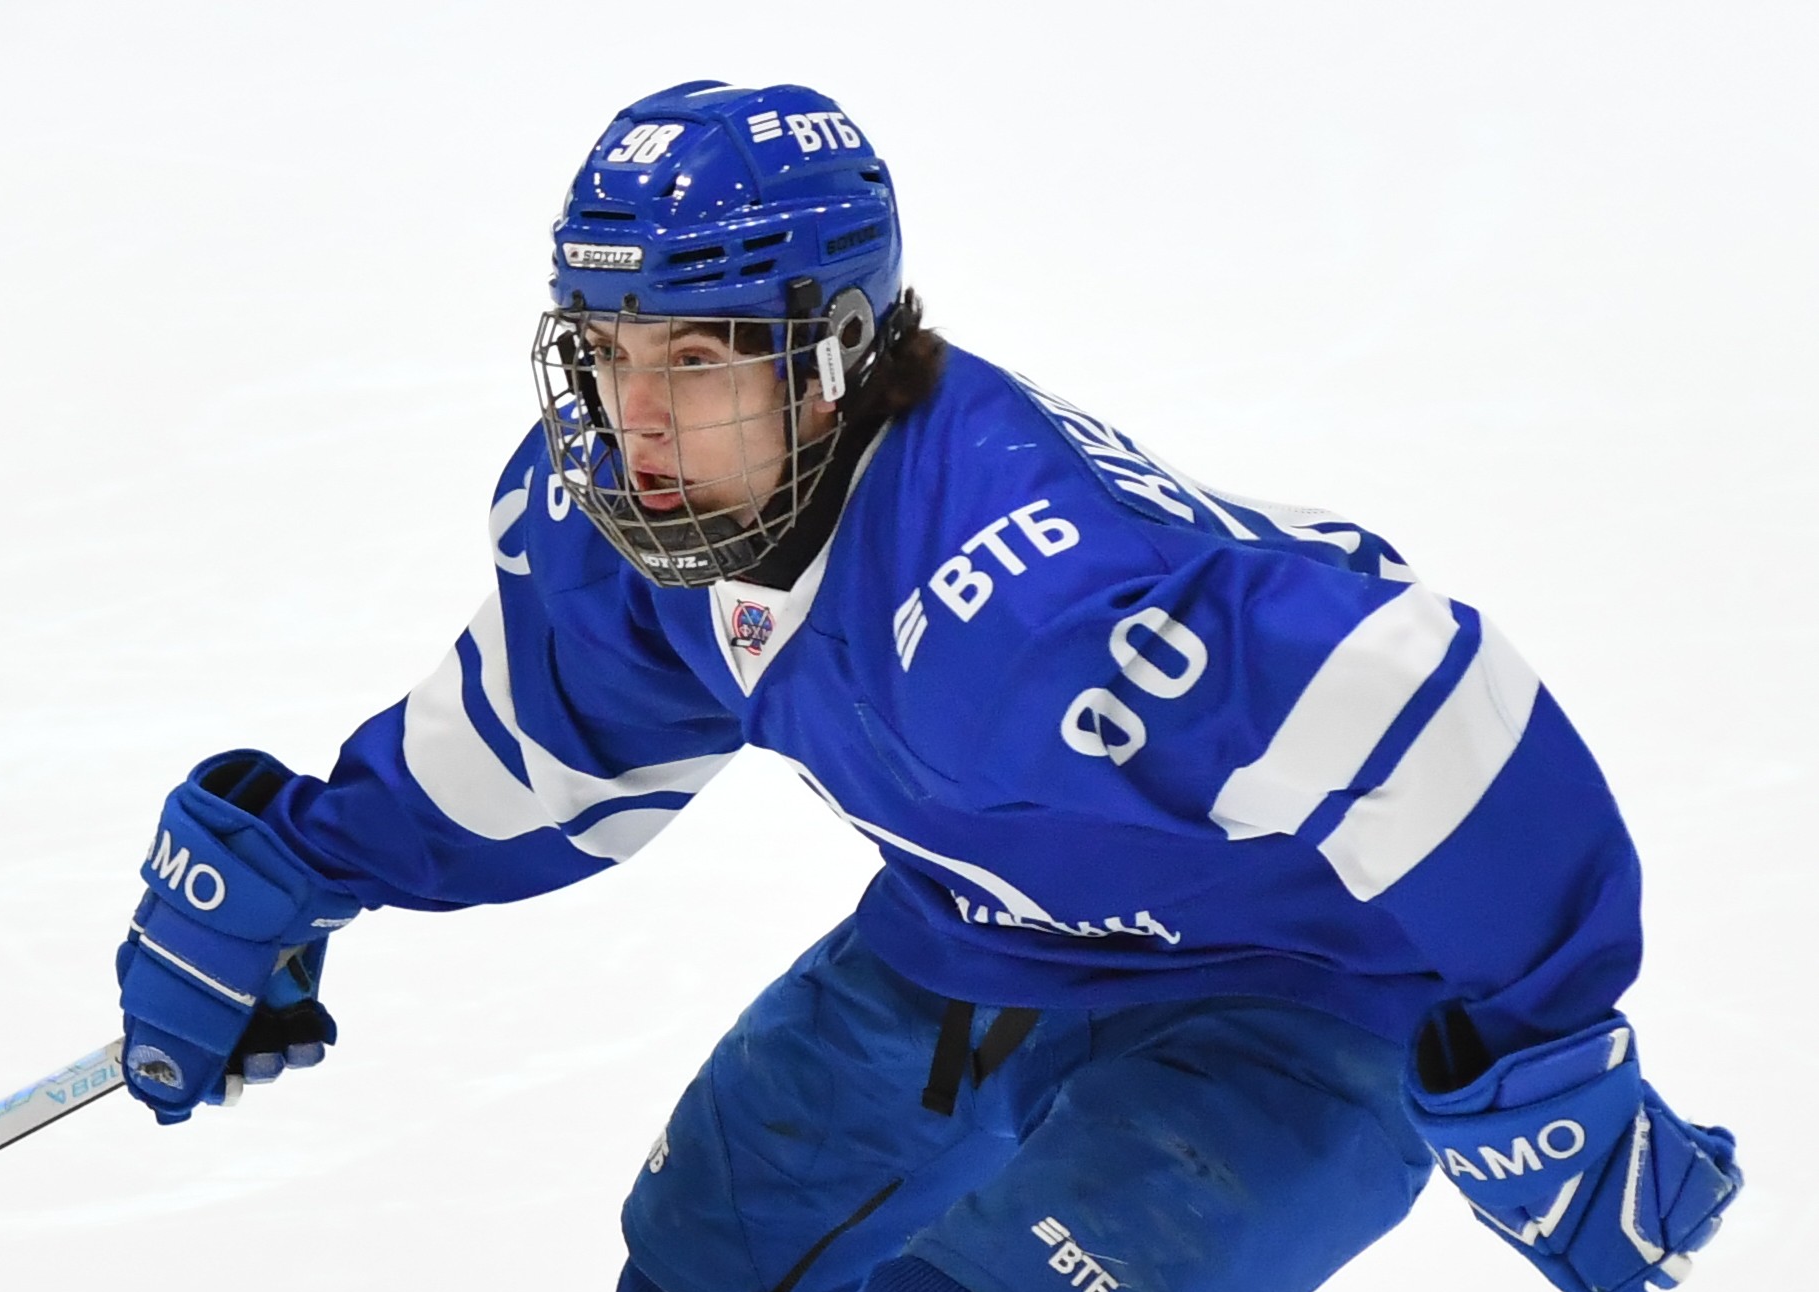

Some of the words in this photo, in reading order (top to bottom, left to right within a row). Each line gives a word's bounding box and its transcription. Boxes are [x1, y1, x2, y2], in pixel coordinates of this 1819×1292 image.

[607, 124, 685, 163] 98
[785, 111, 861, 152] ВТБ
[583, 250, 634, 264] SOYUZ
[927, 499, 1080, 622] ВТБ
